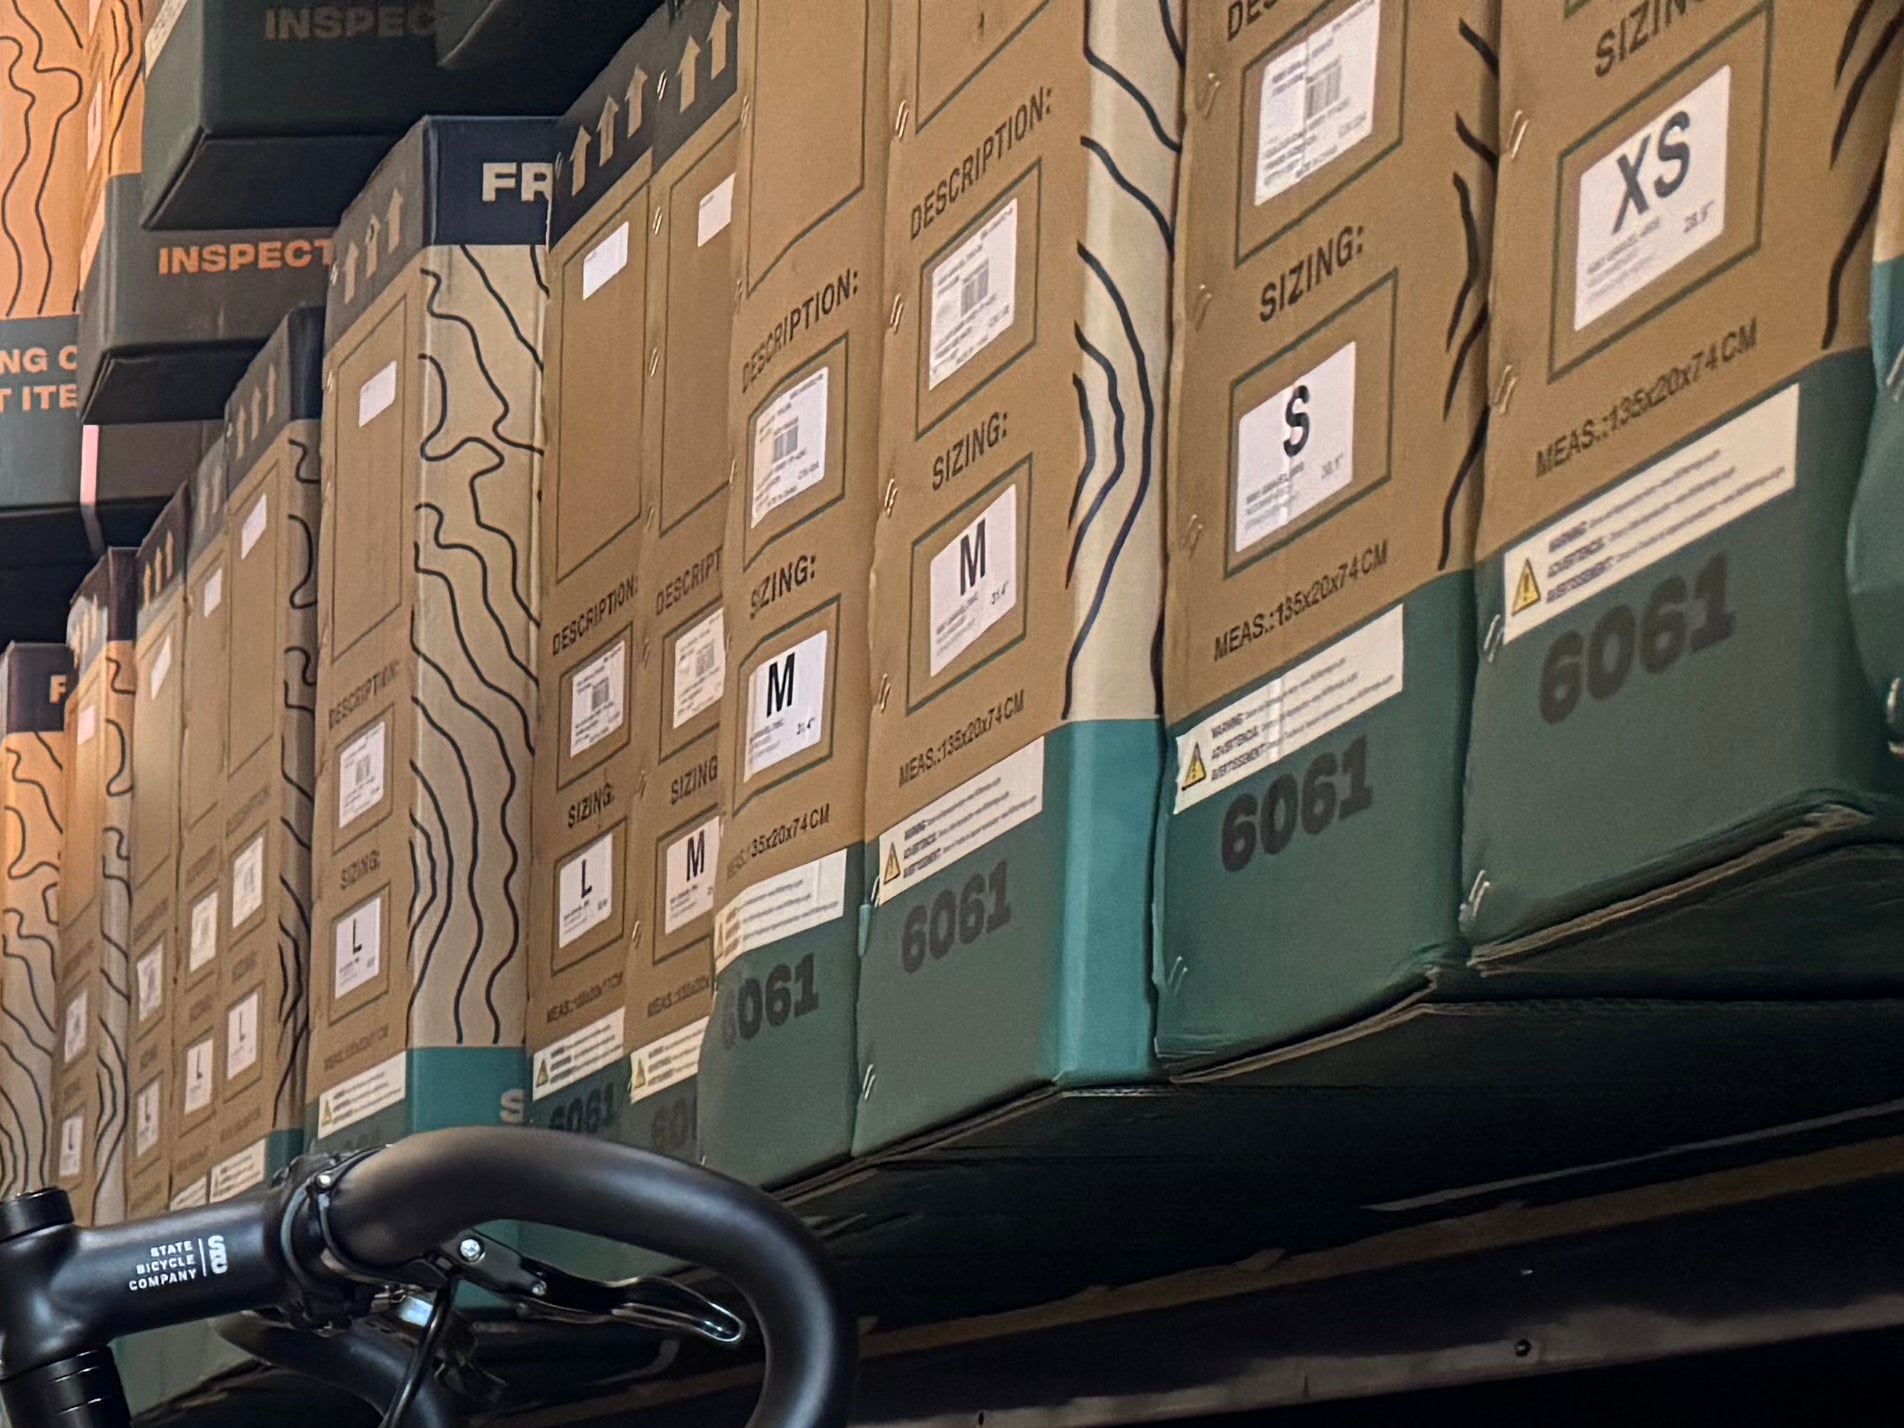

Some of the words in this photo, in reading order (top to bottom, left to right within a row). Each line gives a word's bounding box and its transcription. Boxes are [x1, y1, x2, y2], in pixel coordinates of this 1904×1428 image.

[911, 87, 1052, 240] DESCRIPTION:
[1612, 110, 1690, 234] XS
[158, 239, 333, 275] INSPECT
[1259, 226, 1365, 322] SIZING:
[742, 269, 858, 393] DESCRIPTION:
[932, 412, 1008, 490] SIZING:
[1283, 385, 1311, 456] S
[958, 518, 987, 597] M
[1538, 551, 1738, 726] 6061
[766, 652, 796, 718] M
[1221, 734, 1373, 873] 6061
[581, 859, 593, 899] L
[686, 829, 705, 882] M
[352, 918, 363, 955] L
[901, 860, 1012, 974] 6061
[128, 1268, 197, 1292] COMPANY
[136, 1254, 196, 1276] BICYCLE
[150, 1240, 193, 1258] STATE
